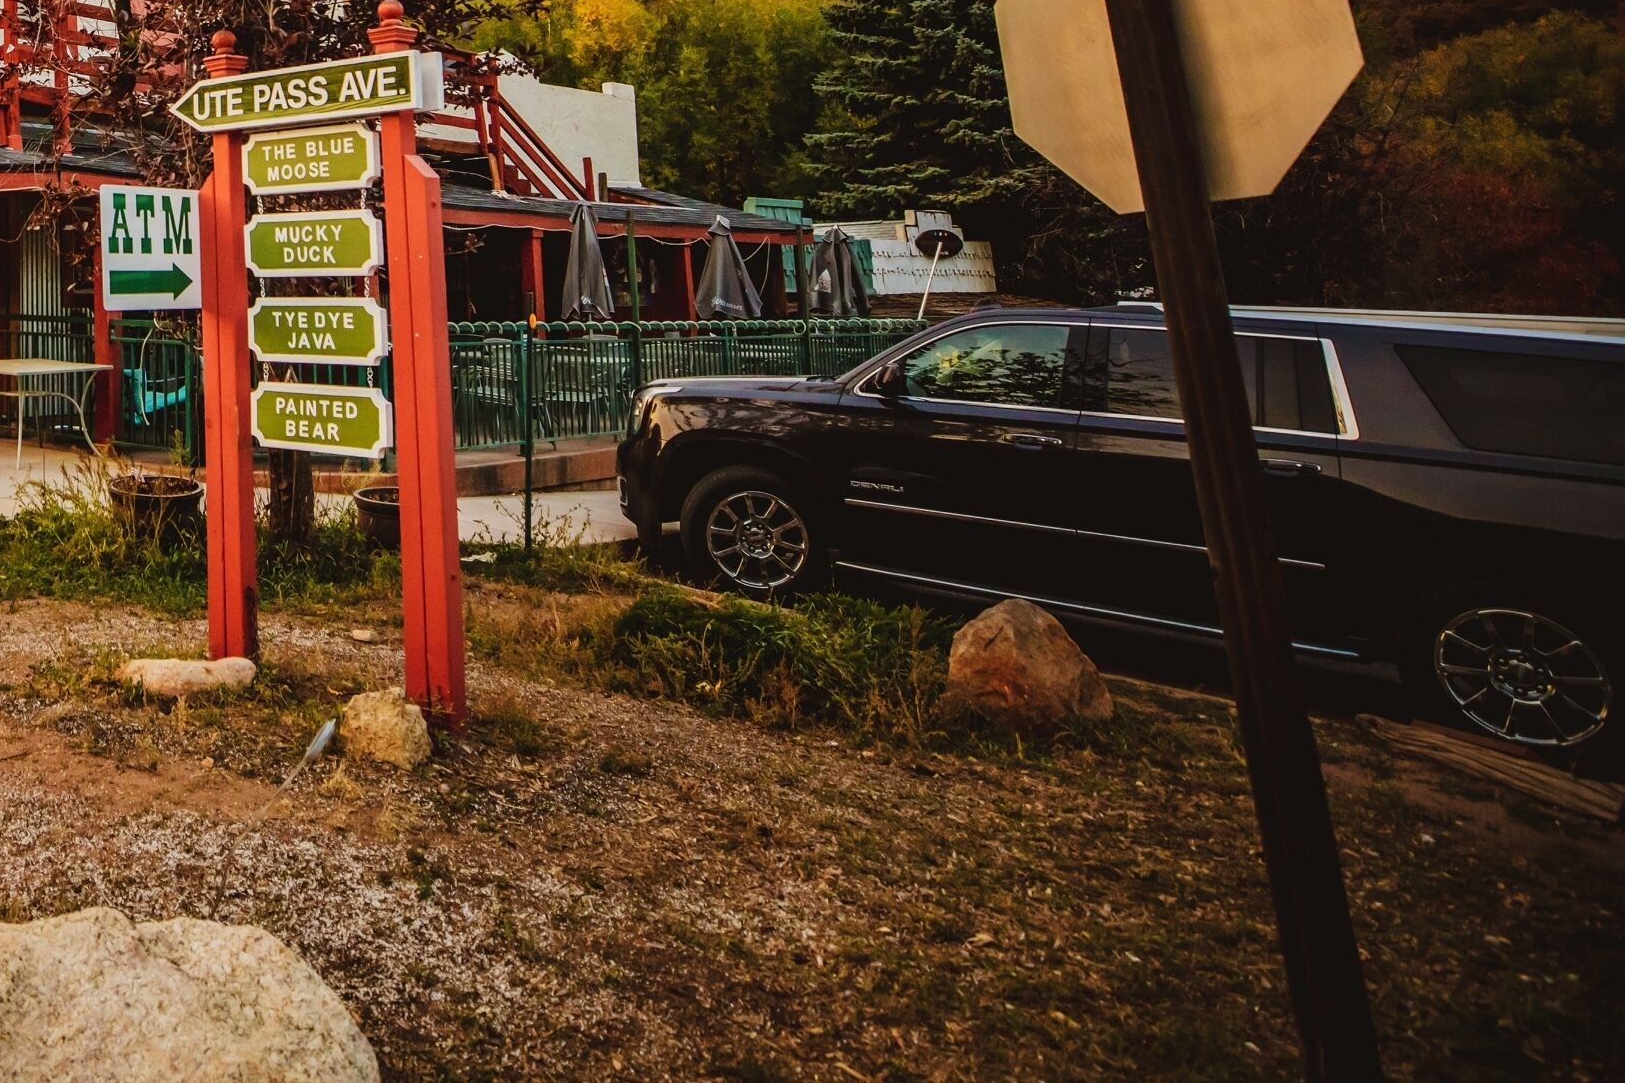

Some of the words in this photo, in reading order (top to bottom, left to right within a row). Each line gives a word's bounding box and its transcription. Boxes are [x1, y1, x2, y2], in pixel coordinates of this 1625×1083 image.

[192, 87, 243, 121] UTE
[253, 77, 329, 113] PASS
[338, 66, 406, 102] AVE.
[262, 143, 296, 161] THE
[305, 137, 355, 156] BLUE
[267, 162, 330, 181] MOOSE
[108, 193, 192, 254] ATM
[275, 225, 342, 243] MUCKY
[283, 246, 336, 264] DUCK
[272, 311, 309, 329] TYE
[315, 311, 355, 329] DYE
[287, 332, 336, 350] JAVA
[275, 397, 358, 418] PAINTED
[285, 420, 339, 441] BEAR
[850, 480, 904, 492] DENALI
